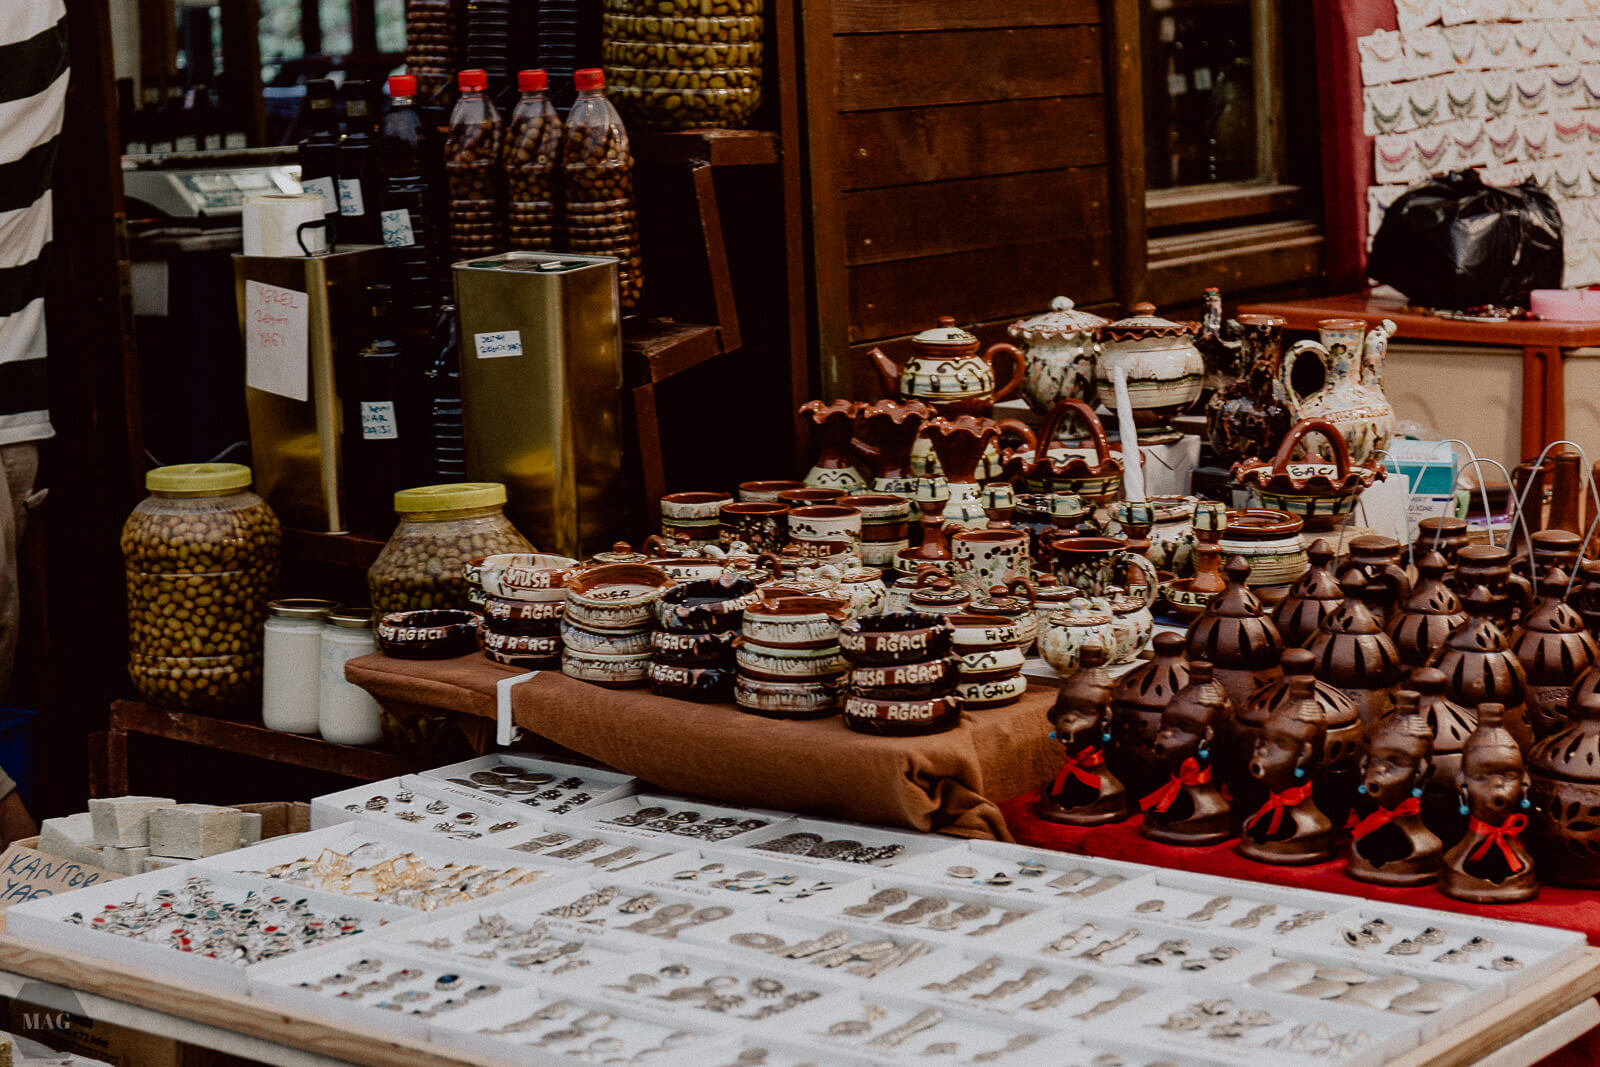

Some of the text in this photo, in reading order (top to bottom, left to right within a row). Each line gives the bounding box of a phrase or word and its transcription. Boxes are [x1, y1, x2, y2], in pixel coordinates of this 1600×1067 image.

[876, 633, 928, 653] AĞACI
[893, 663, 944, 685] AĞACI
[887, 702, 935, 721] AĞACI
